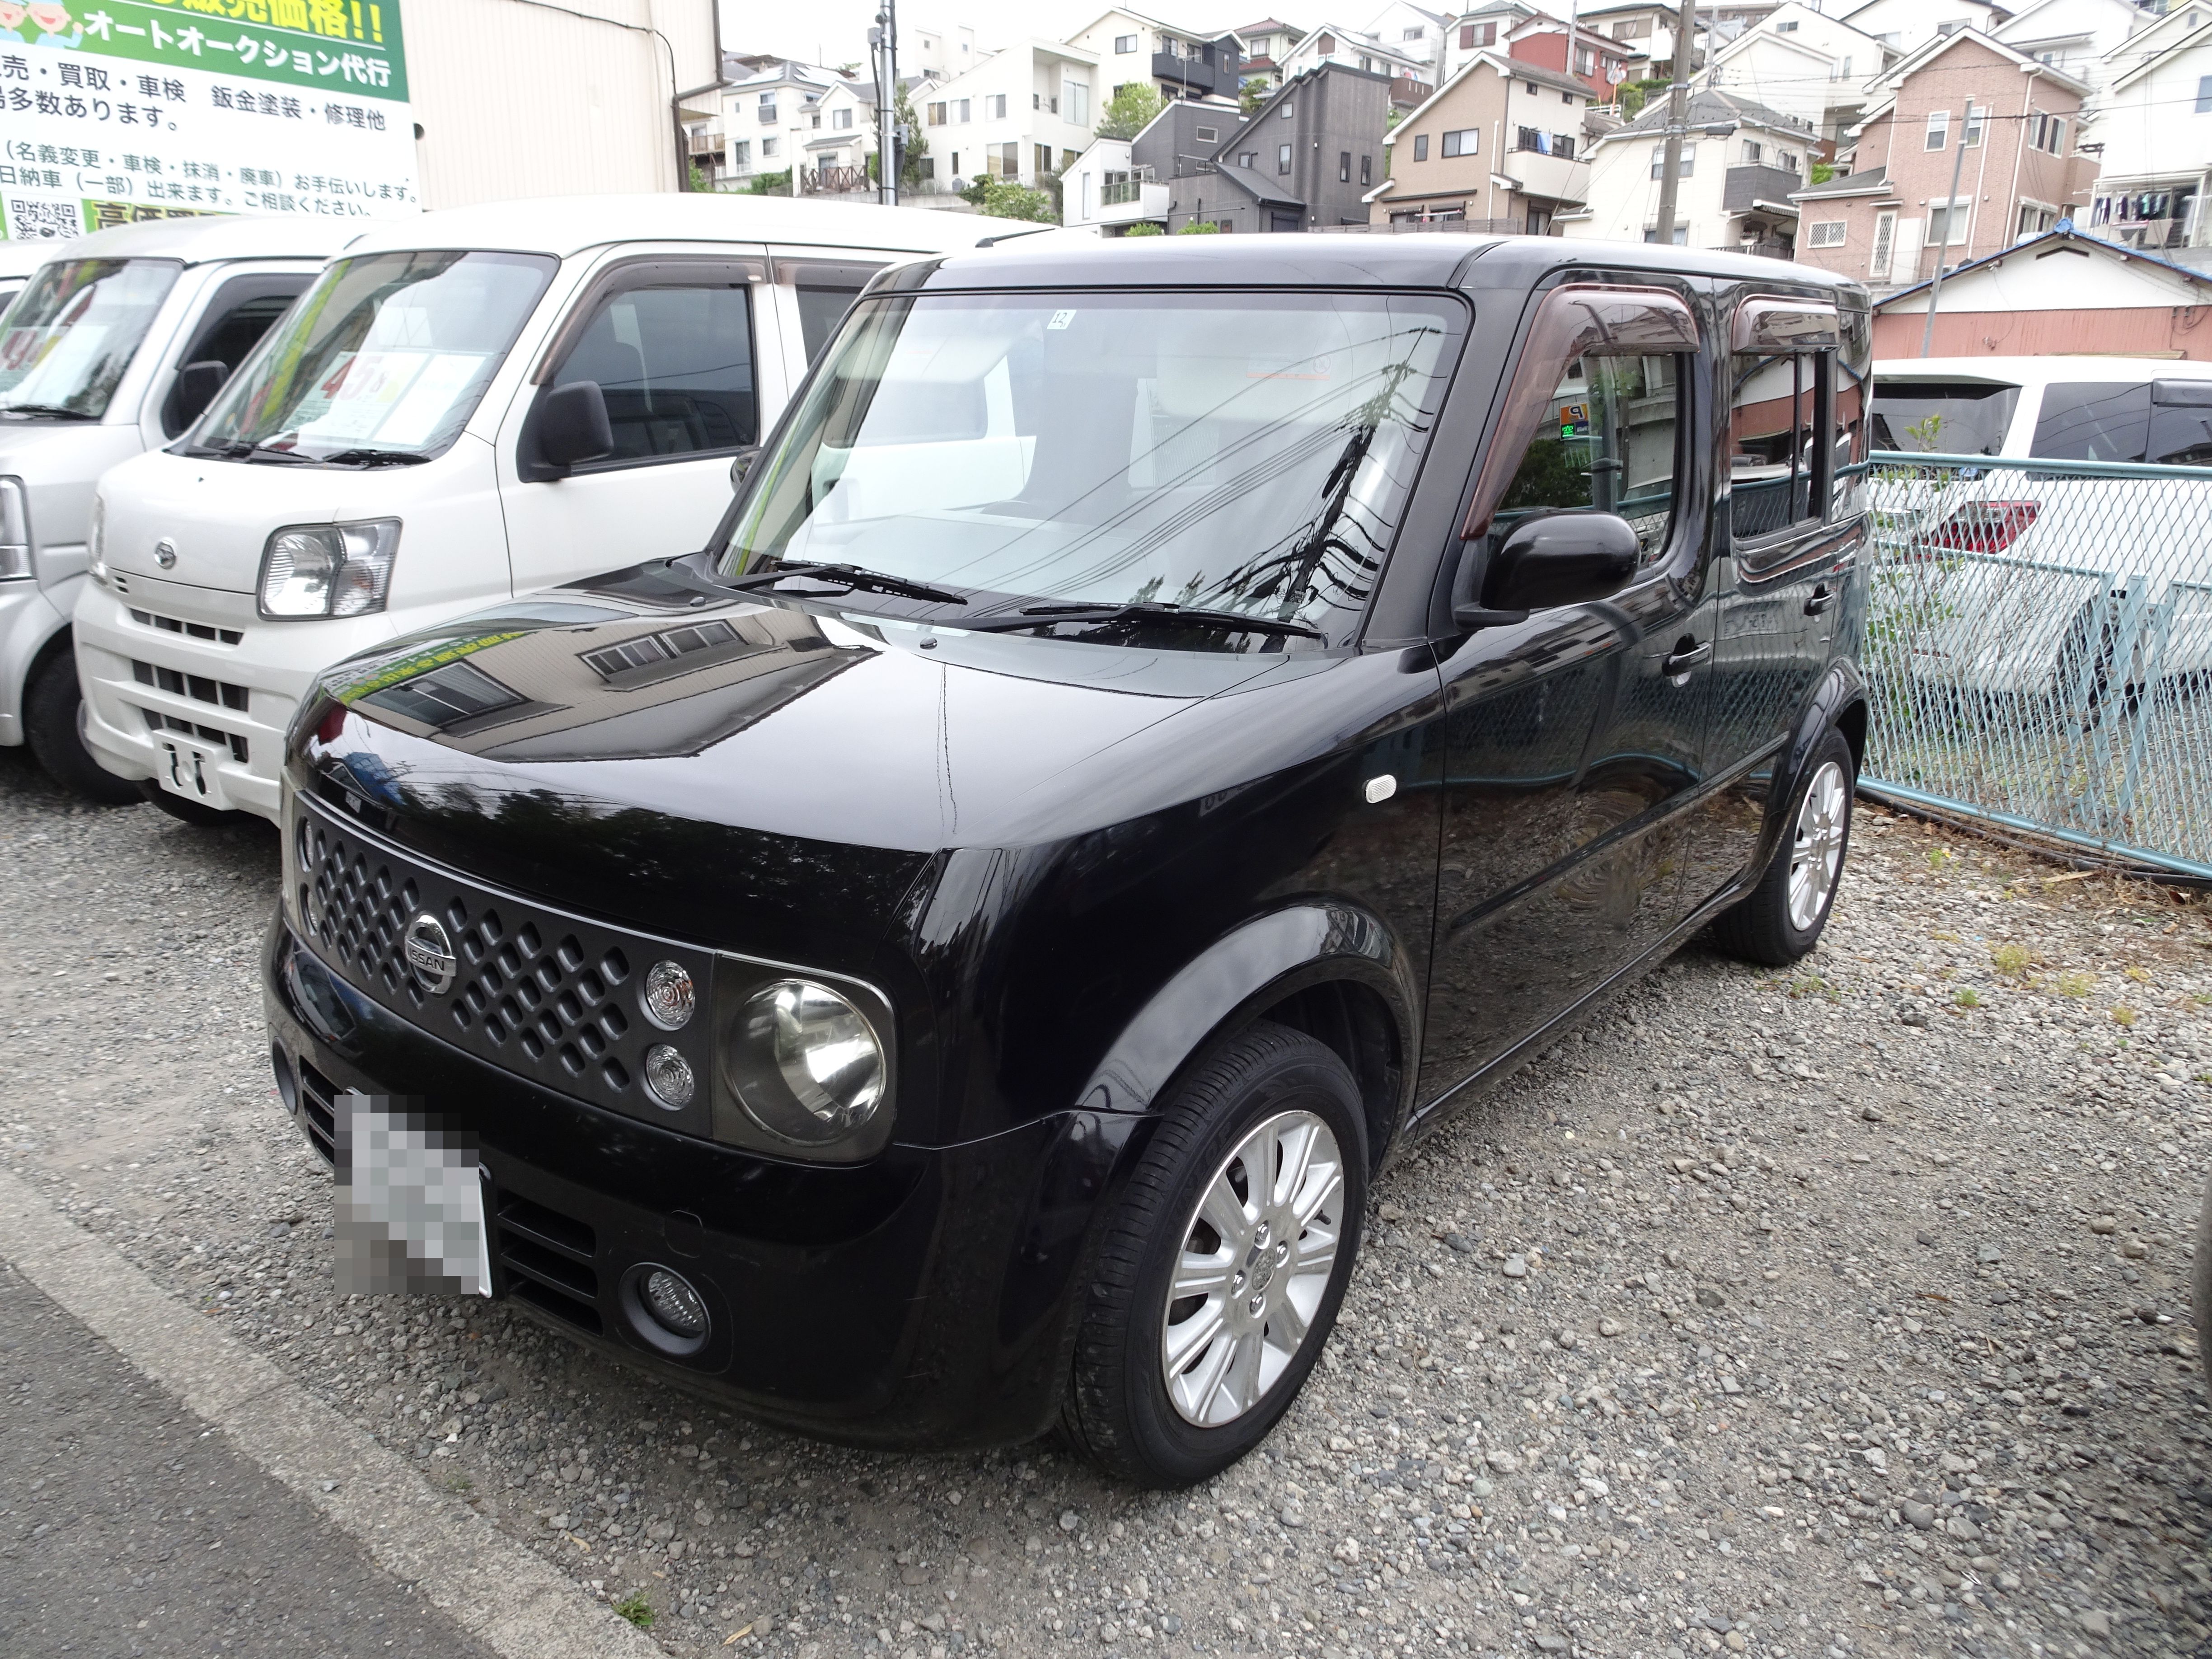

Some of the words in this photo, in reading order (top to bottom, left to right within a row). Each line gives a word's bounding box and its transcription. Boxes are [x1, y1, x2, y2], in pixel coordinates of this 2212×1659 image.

[84, 9, 392, 88] オートオークション代行
[0, 54, 187, 103] 売・買取・車検
[211, 84, 386, 131] 鈑金塗装・修理他
[0, 86, 178, 131] 多数あります。
